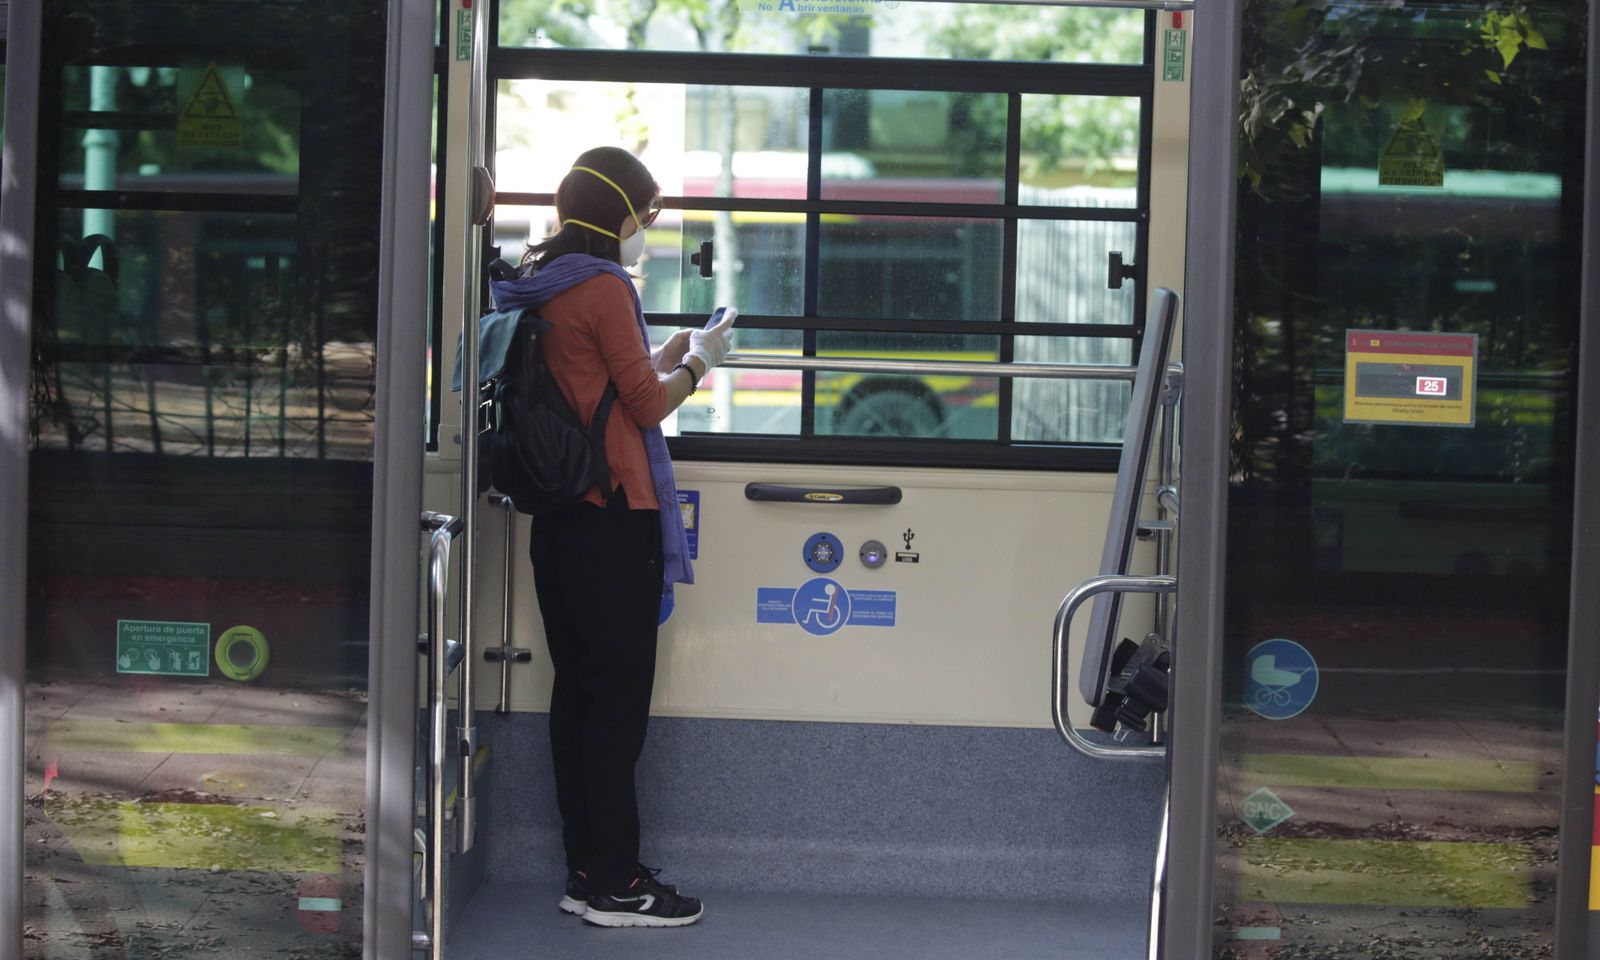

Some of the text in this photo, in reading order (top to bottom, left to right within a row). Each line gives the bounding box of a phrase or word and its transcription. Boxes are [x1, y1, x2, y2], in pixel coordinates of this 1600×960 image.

[758, 3, 772, 11] No
[1424, 380, 1439, 391] 25
[123, 624, 205, 635] Apertura de puerta
[144, 635, 196, 644] emergencia
[1243, 801, 1281, 820] GNC
